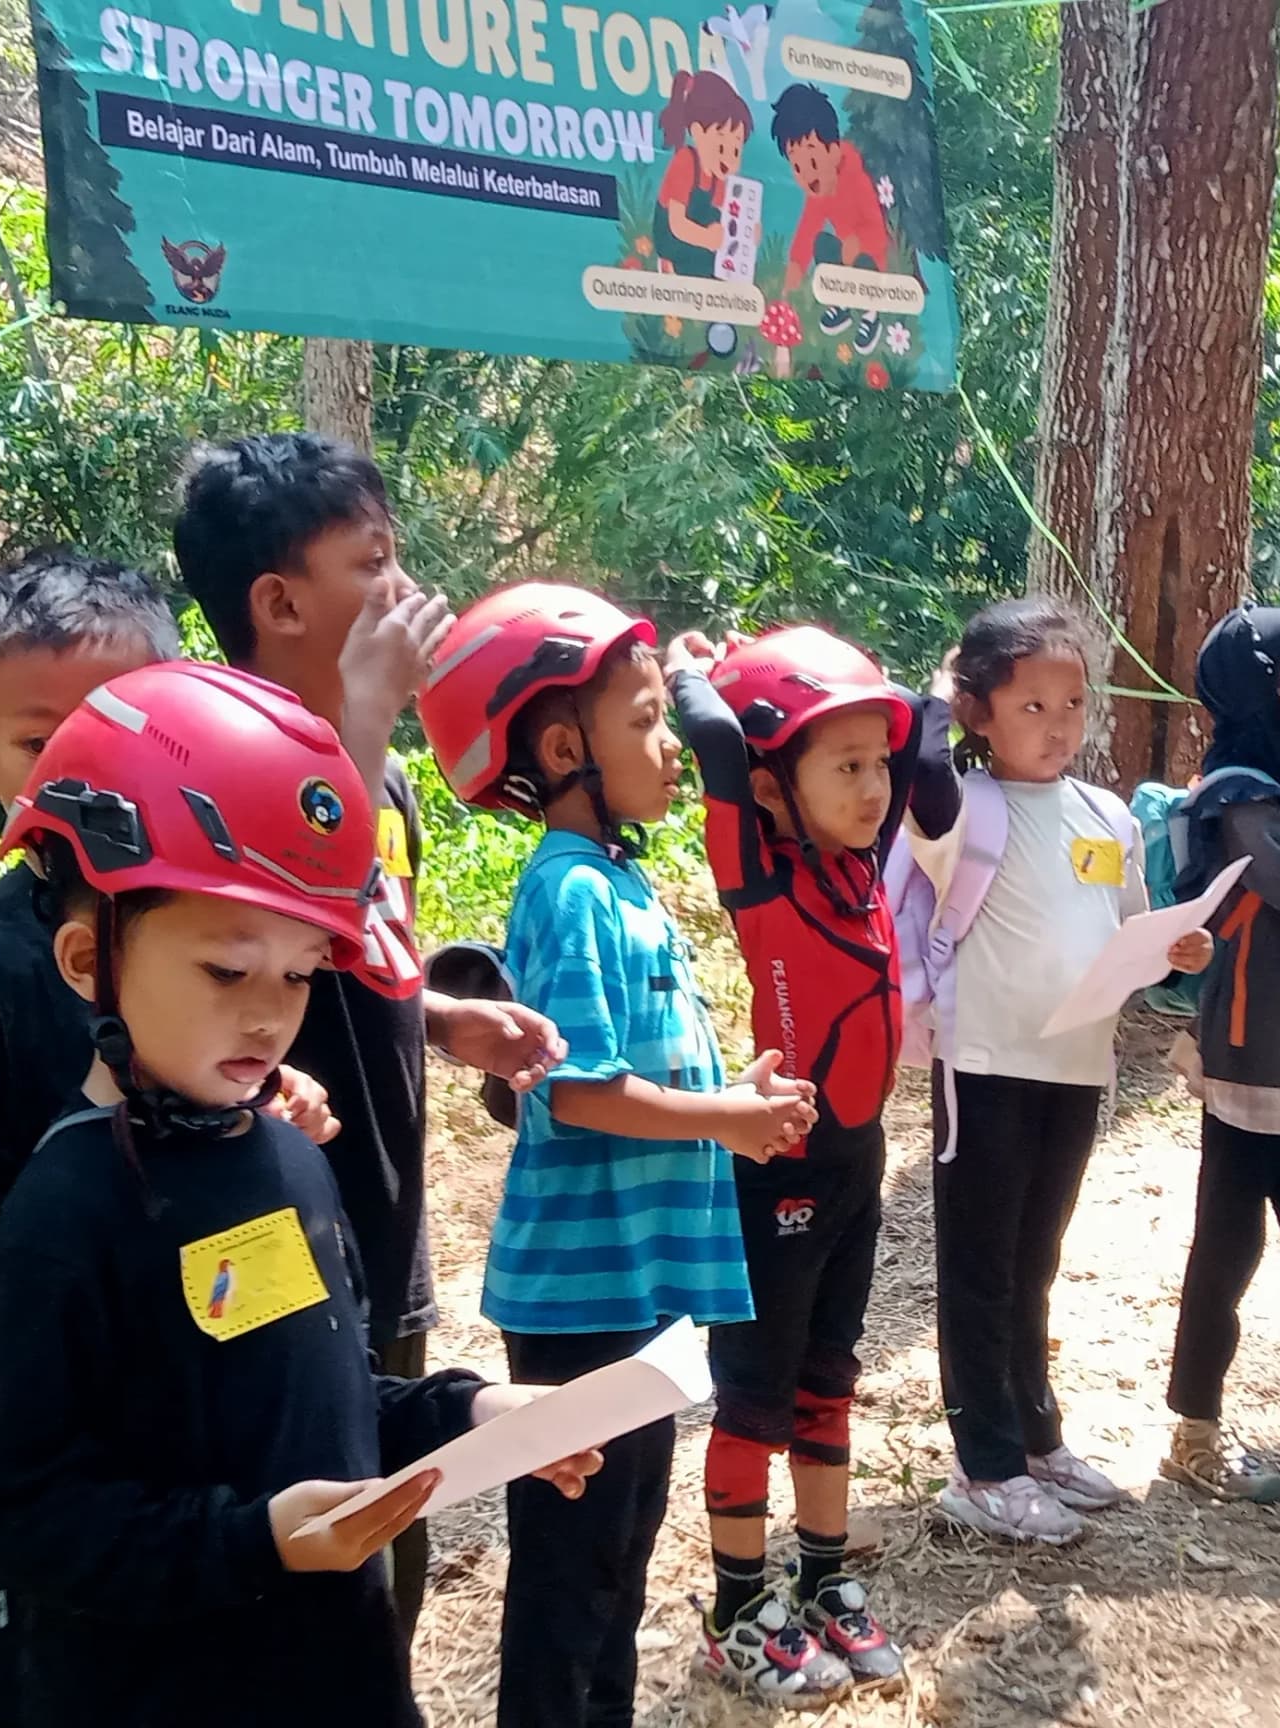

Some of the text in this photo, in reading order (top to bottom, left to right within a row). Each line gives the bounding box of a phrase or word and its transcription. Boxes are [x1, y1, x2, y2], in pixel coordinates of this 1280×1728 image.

[99, 7, 656, 164] STRONGER TOMORROW
[231, 0, 769, 101] NTURE TODAY
[788, 47, 906, 88] Fun team challenges
[126, 109, 602, 208] Belajar Dari Alam, Tumbuh Melalui Keterbatasan
[592, 278, 758, 313] Outdoor learning activities
[819, 275, 857, 295] Nature
